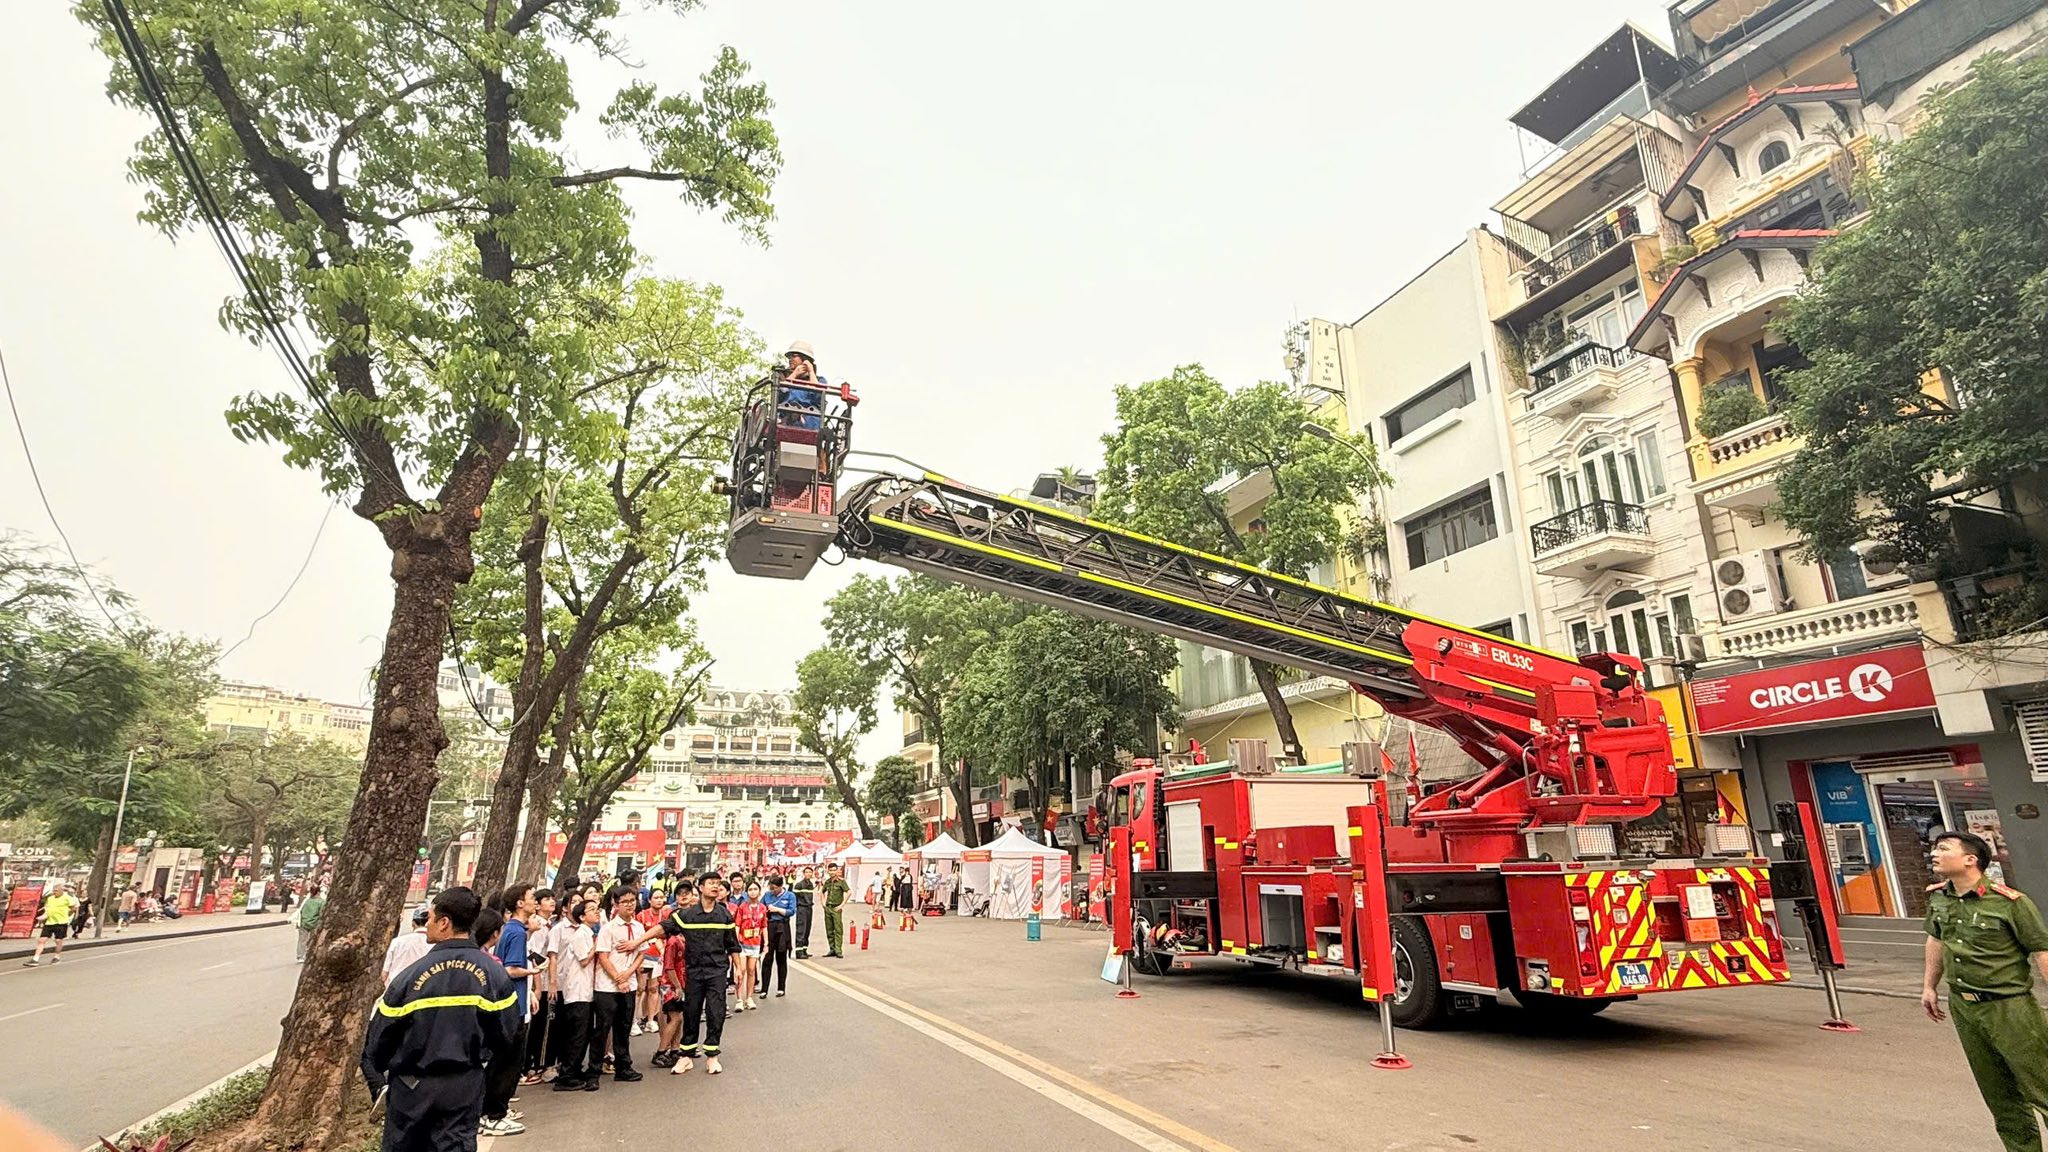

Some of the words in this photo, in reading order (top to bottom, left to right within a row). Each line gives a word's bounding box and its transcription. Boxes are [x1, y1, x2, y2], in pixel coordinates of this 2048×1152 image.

[1491, 647, 1534, 672] ERL33C
[1749, 676, 1844, 709] CIRCLE
[1857, 667, 1892, 701] K
[1827, 791, 1848, 801] VIB
[9, 847, 54, 856] CONY
